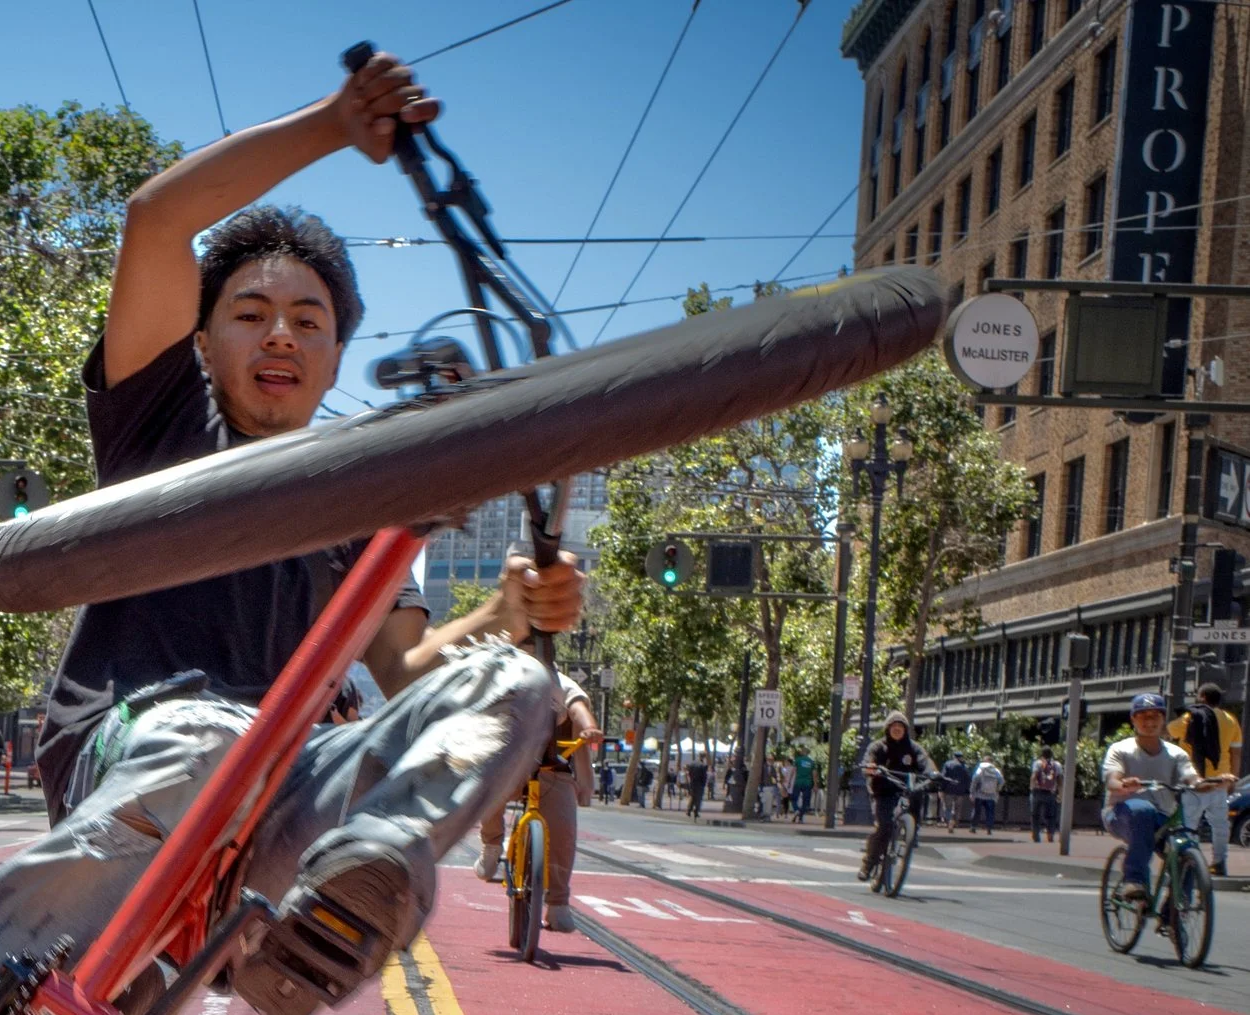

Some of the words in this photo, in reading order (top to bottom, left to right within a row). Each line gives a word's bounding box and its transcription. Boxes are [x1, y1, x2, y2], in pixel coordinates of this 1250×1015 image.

[1139, 3, 1191, 285] PROPE
[971, 322, 1023, 337] JONES
[961, 346, 1030, 363] McALLISTER
[1203, 631, 1247, 640] JONES
[760, 707, 775, 719] 10
